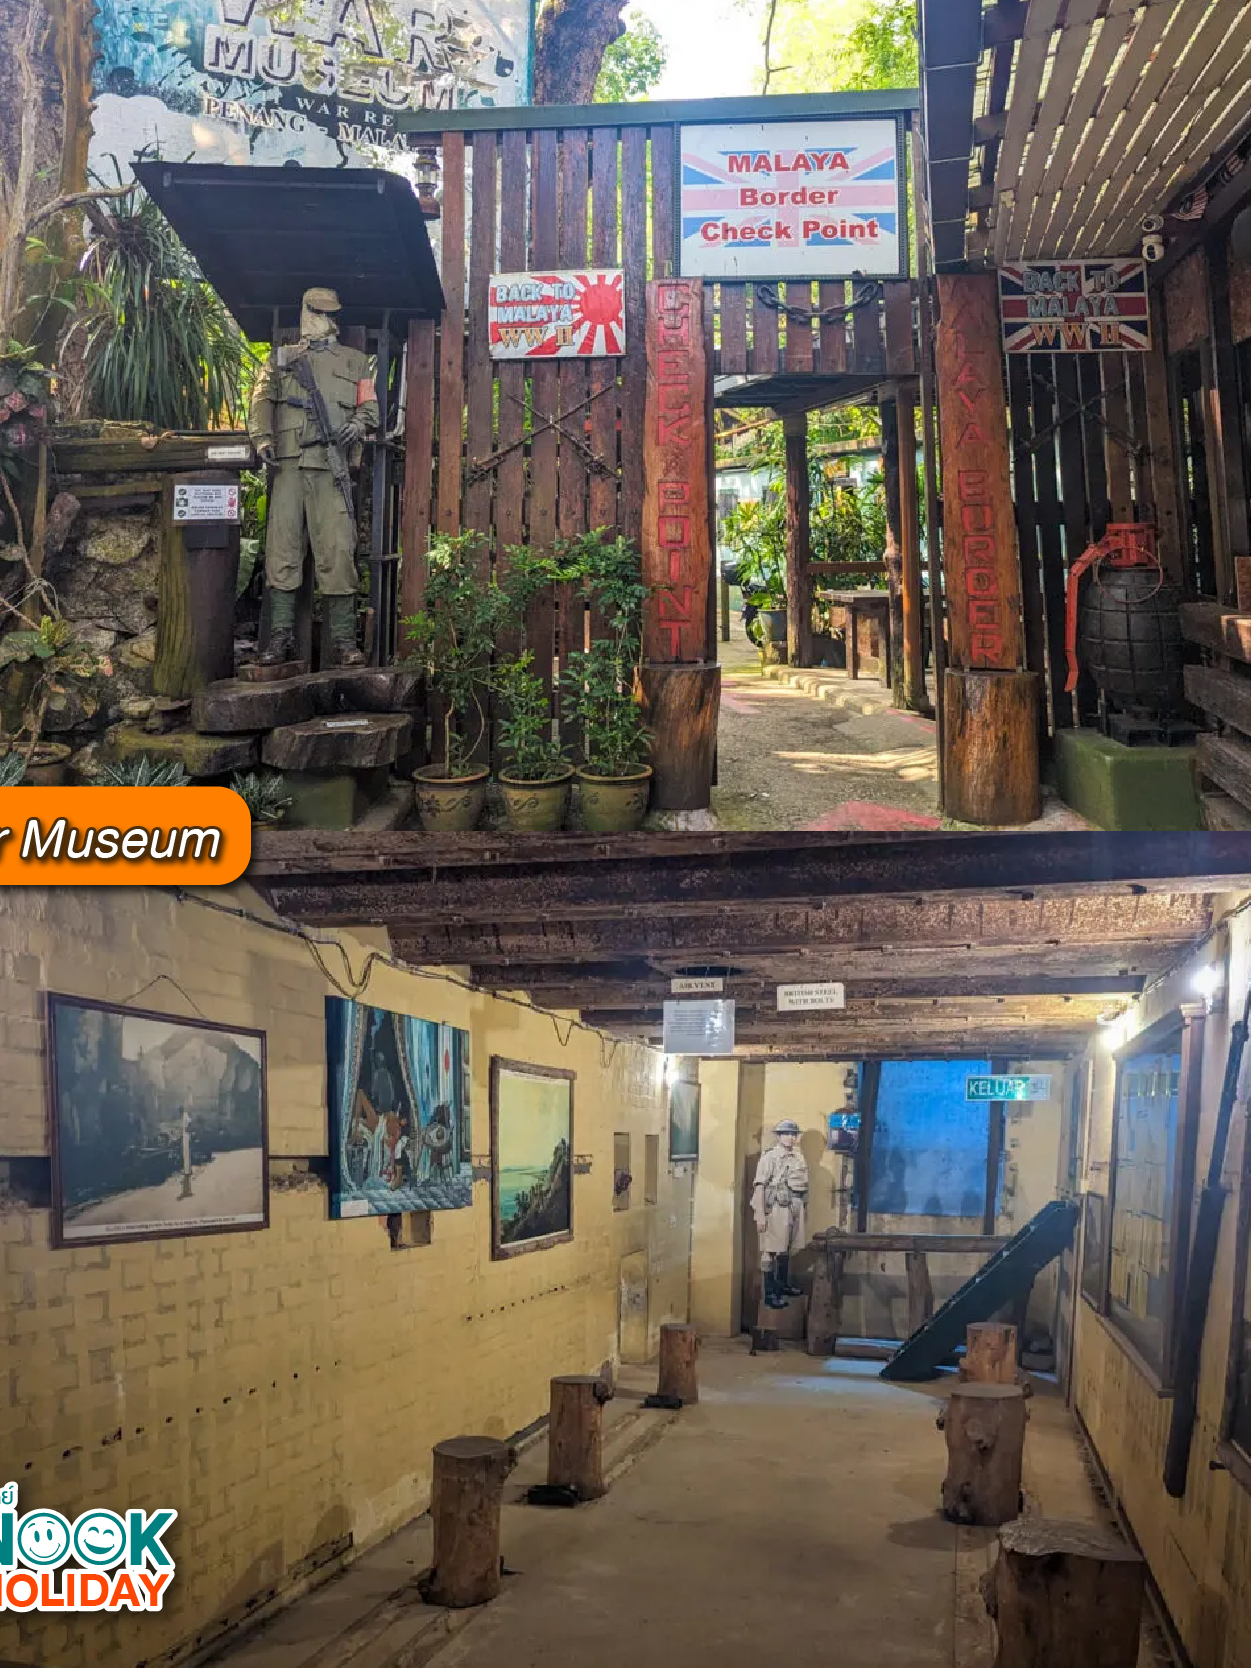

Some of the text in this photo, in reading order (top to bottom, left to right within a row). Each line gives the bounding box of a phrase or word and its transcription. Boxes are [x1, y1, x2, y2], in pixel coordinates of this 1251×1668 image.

[204, 97, 306, 131] PENANG
[297, 97, 352, 118] WAR
[728, 152, 849, 173] MALAYA
[740, 187, 839, 205] Border
[702, 219, 878, 240] Check Point
[1023, 267, 1120, 292] BACK TO
[496, 281, 576, 303] BACK TO
[497, 304, 574, 324] MALAYA
[1026, 295, 1120, 318] MALAYA
[498, 327, 548, 347] WW
[1031, 322, 1088, 346] WW
[657, 283, 690, 446] CHECK
[657, 481, 691, 657] POINT
